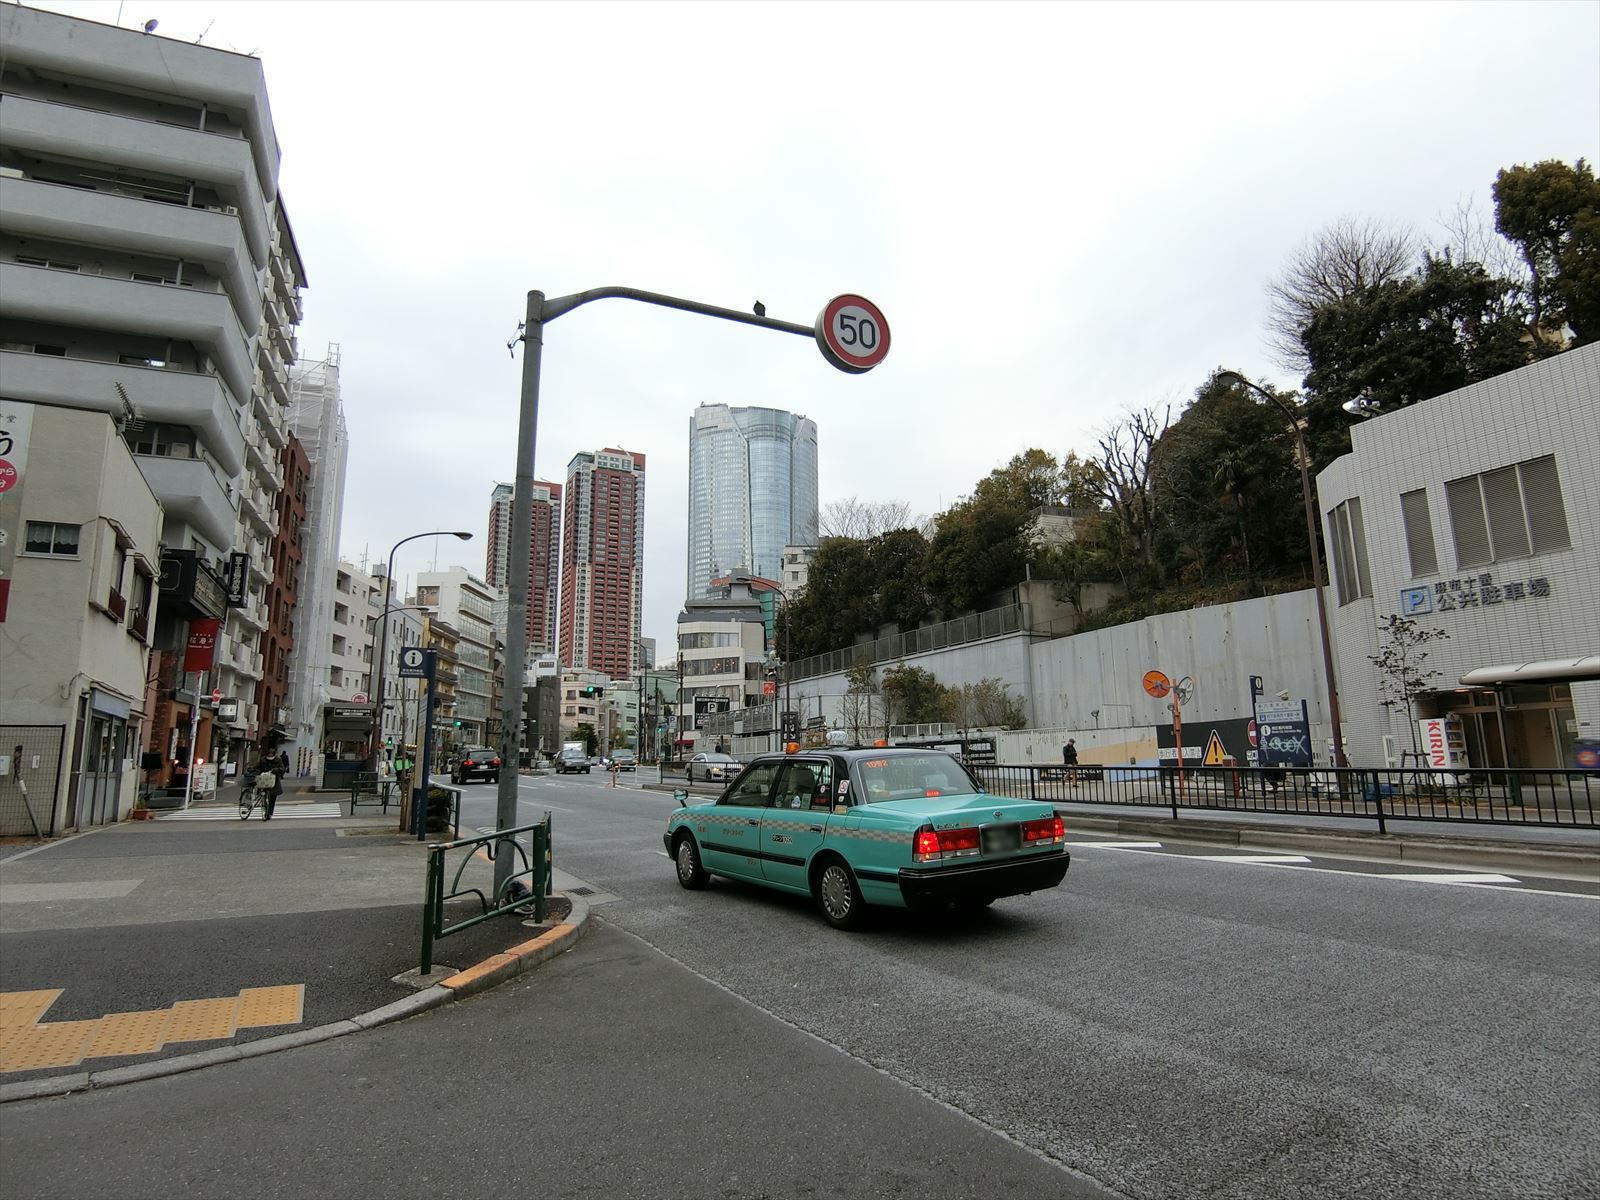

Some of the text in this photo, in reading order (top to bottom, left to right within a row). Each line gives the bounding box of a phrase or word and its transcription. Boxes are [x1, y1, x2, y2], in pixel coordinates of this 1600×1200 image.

[839, 314, 876, 349] 50
[1437, 577, 1551, 612] 公共駐車場
[1427, 721, 1446, 767] KIRIN
